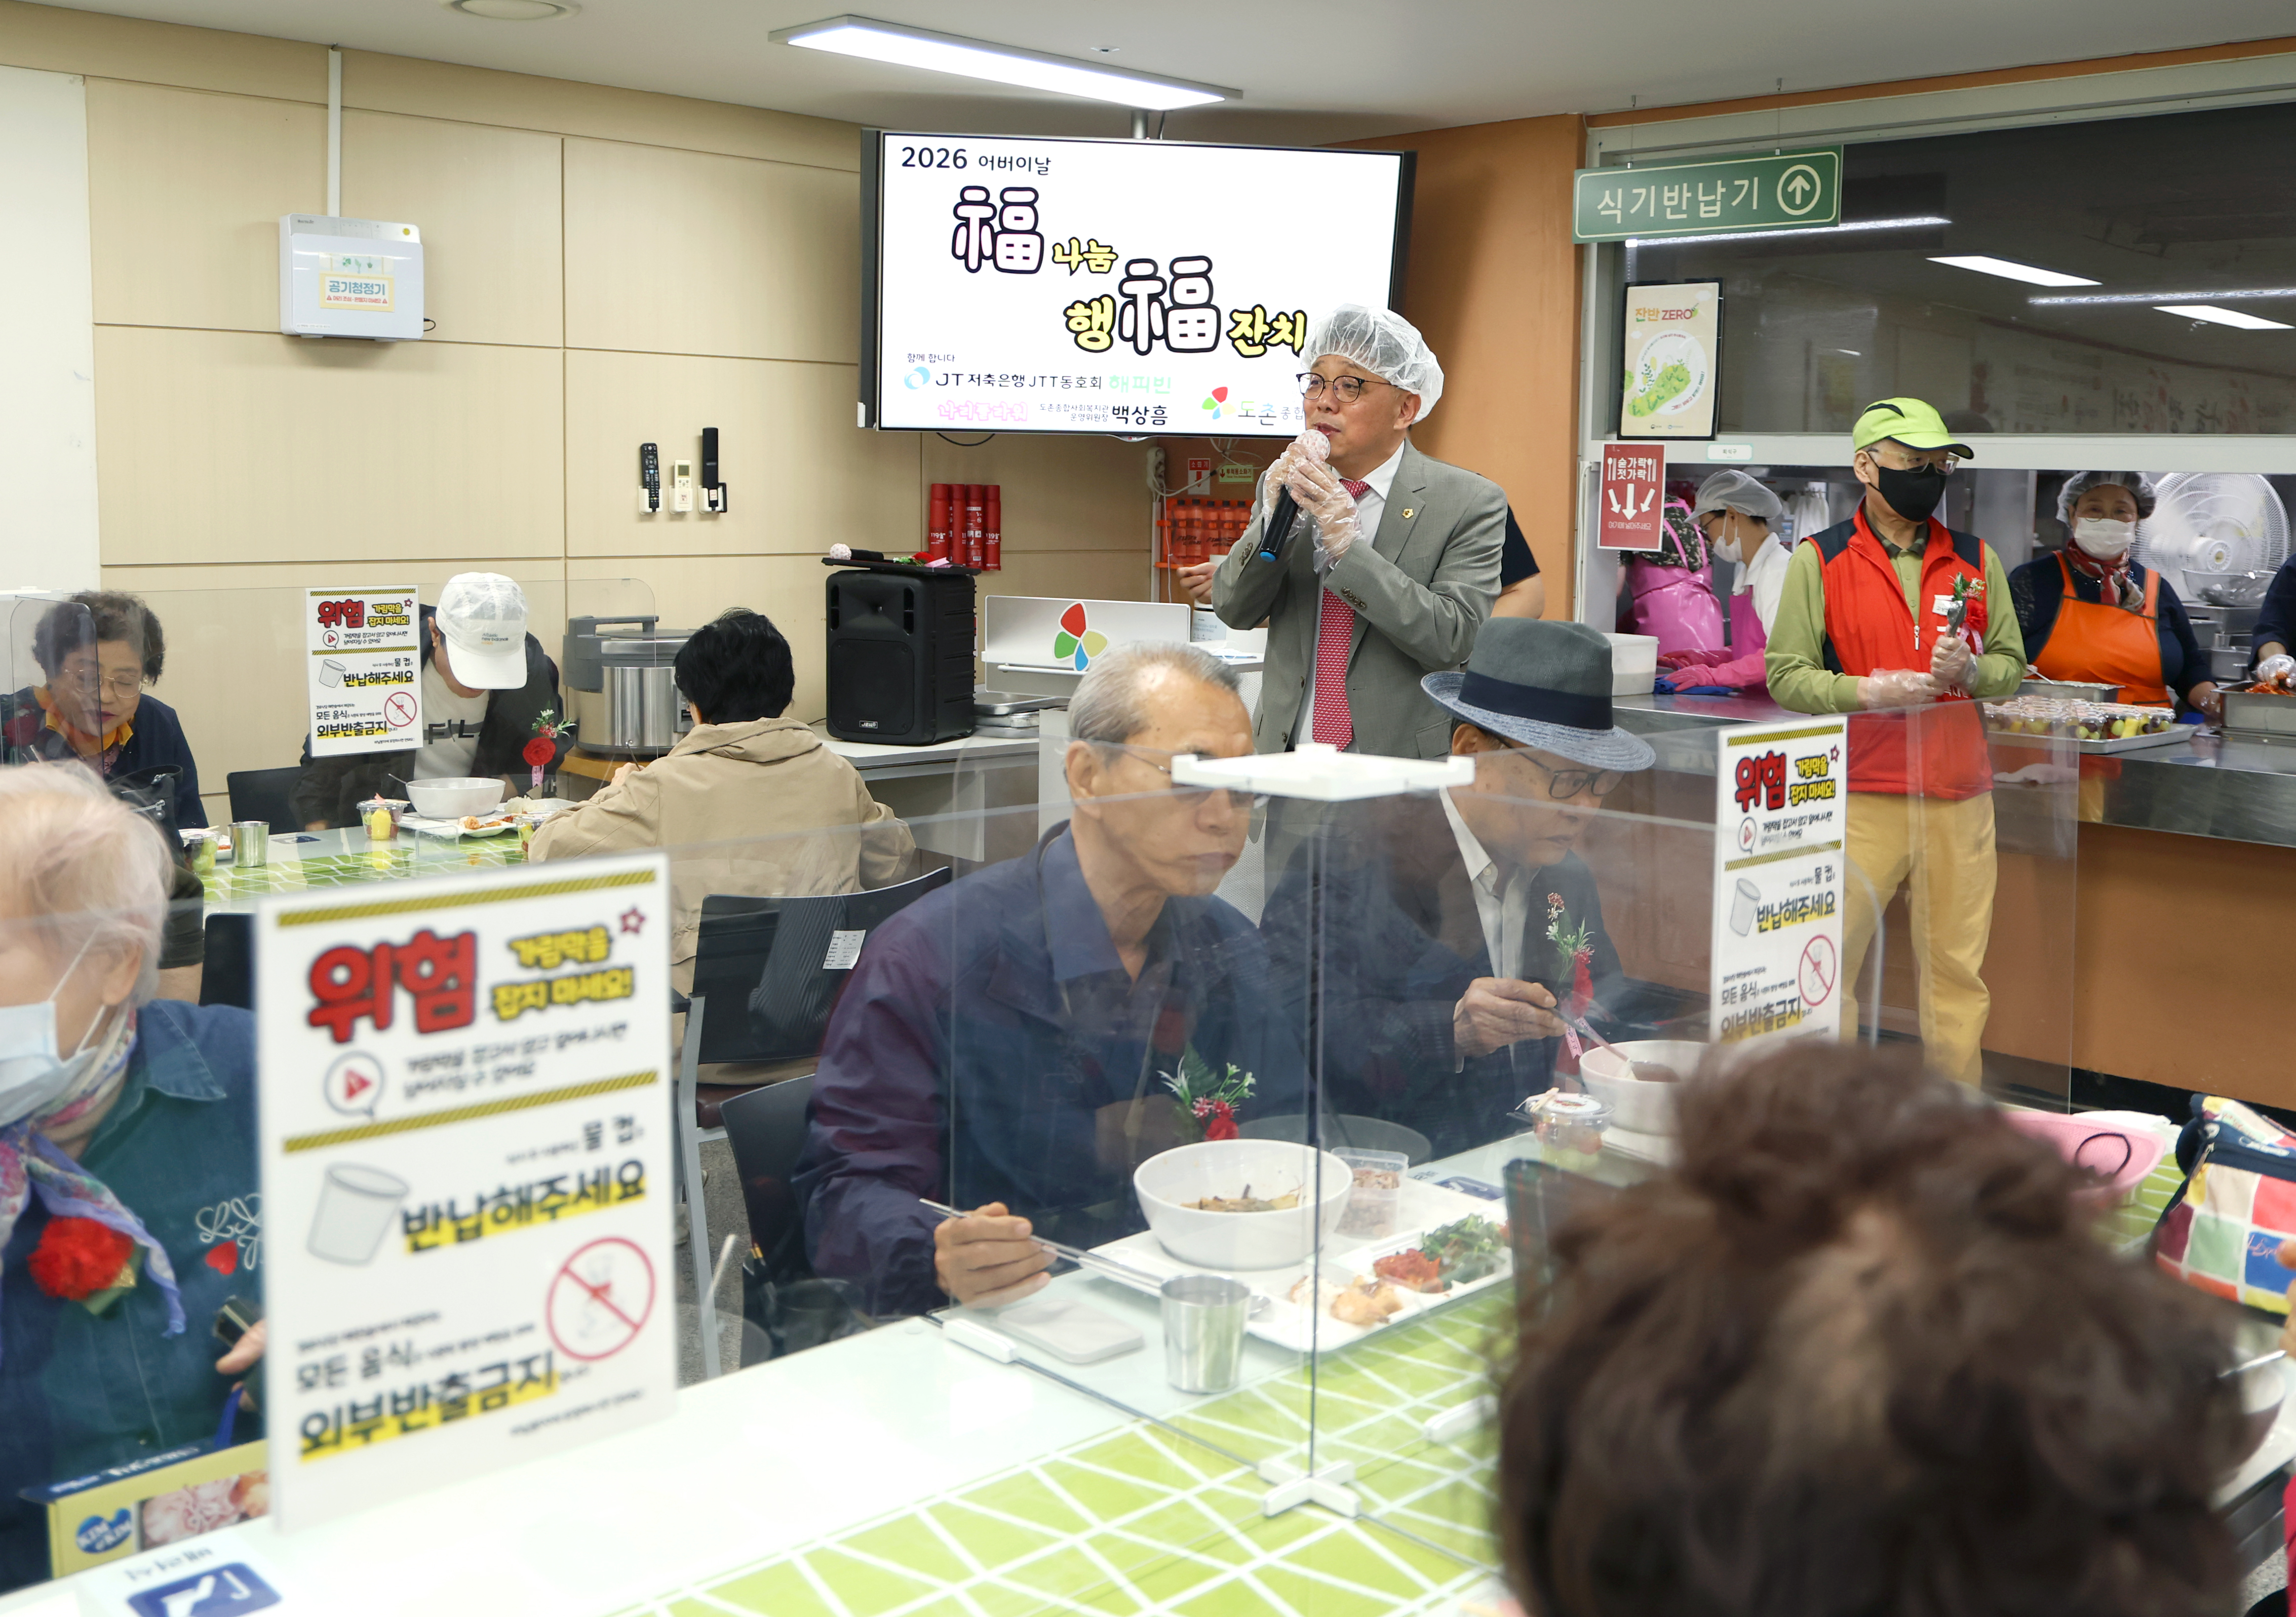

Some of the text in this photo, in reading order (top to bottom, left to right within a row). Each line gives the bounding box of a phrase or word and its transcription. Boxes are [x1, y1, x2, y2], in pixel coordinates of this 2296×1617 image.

[902, 147, 1051, 175] 2026 어버이날
[1597, 177, 1758, 224] 식기반납기
[952, 186, 1119, 276] 福 나눔
[329, 280, 385, 295] 공기청정기
[1635, 307, 1693, 322] 잔반 ZERO
[1226, 304, 1308, 358] 잔치
[907, 353, 955, 363] 함께 합니다
[1108, 374, 1171, 394] 해피빈
[937, 399, 1028, 422] 나리플라워
[1040, 403, 1109, 413] 도촌종합사회복지관
[1070, 413, 1109, 423] 운영위원장
[1112, 405, 1168, 425] 백상흠
[1617, 457, 1647, 468] 숟가락
[1617, 469, 1647, 480] 젓가락
[317, 599, 365, 628] 위험
[372, 603, 403, 615] 가림막을
[367, 615, 410, 627] 잡지 마세요!
[394, 658, 401, 667] 물
[343, 670, 414, 688] 반납해주세요
[316, 711, 330, 720] 모든
[428, 719, 482, 745] FIL
[1795, 753, 1829, 779] 가림막을
[1735, 749, 1787, 812] 위험
[1789, 778, 1836, 807] 잡지 마세요!
[1757, 890, 1835, 933] 반납해주세요
[507, 924, 614, 971] 가림막을
[307, 927, 478, 1044] 위험
[399, 1158, 646, 1255] 반납해주세요
